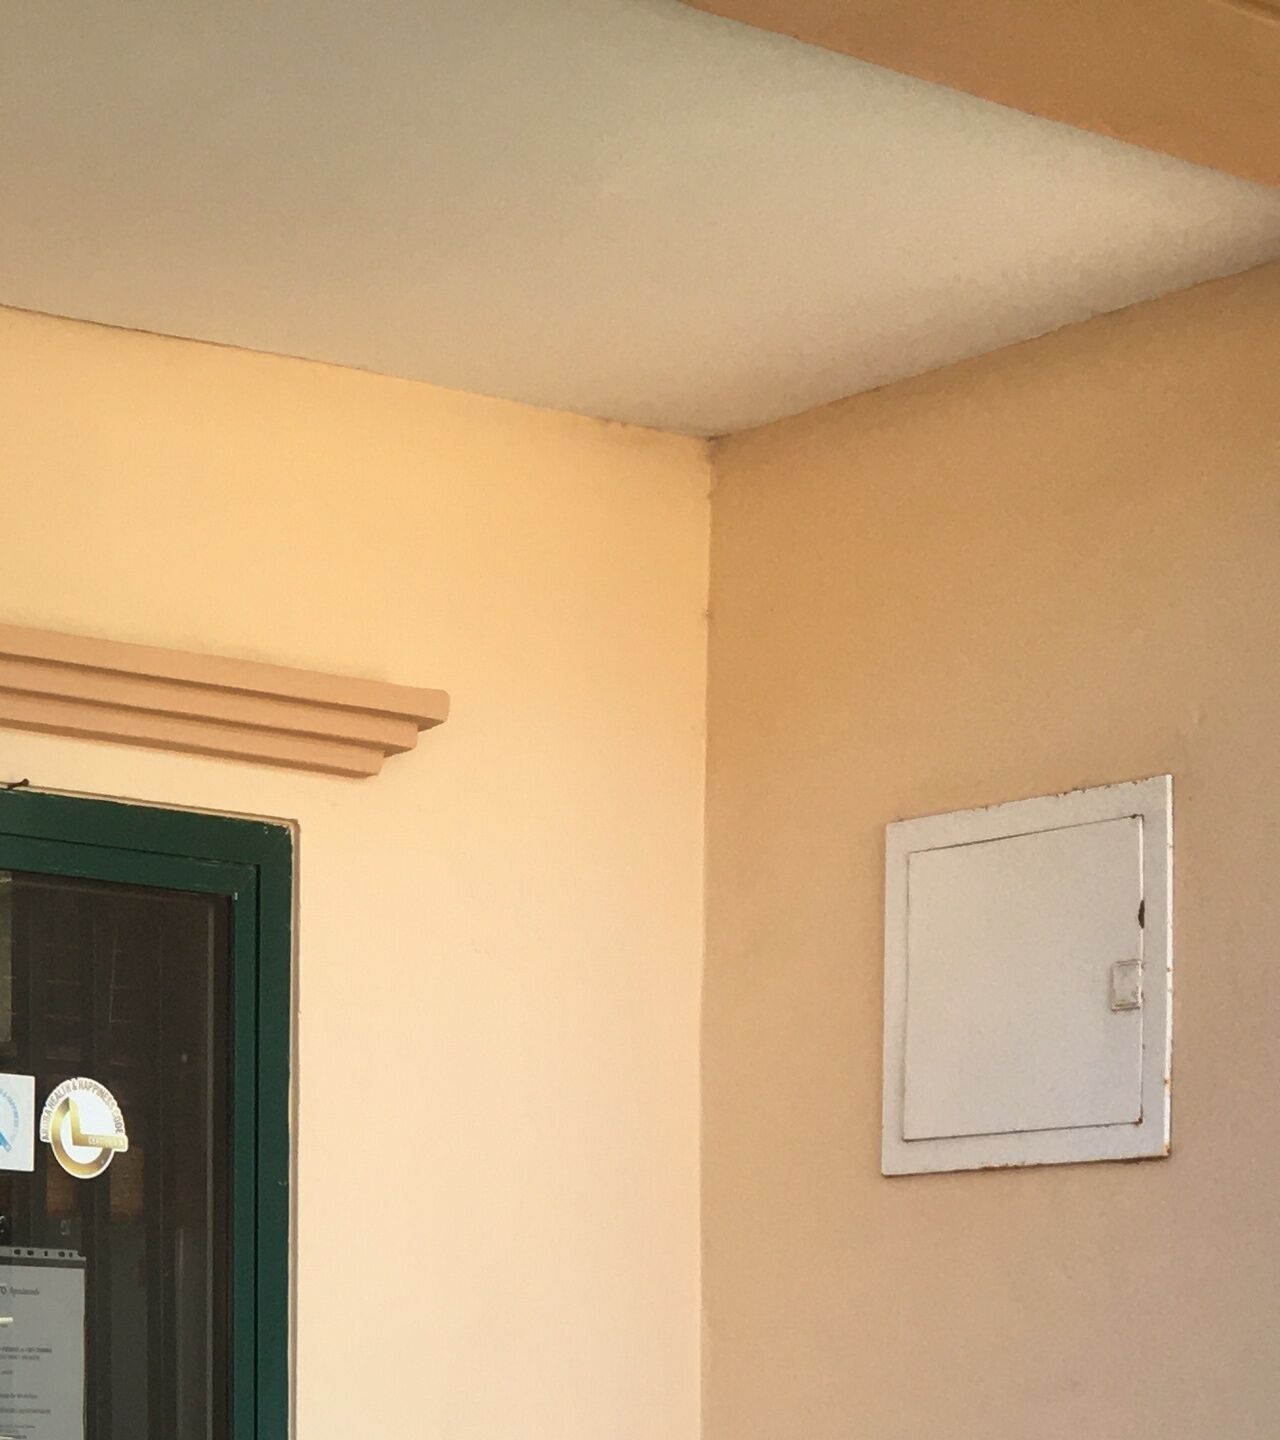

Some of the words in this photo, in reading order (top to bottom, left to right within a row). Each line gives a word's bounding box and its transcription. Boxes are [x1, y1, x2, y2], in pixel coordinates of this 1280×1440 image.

[41, 1109, 52, 1141] ARUBA
[48, 1083, 72, 1109] HEALTH
[78, 1079, 116, 1110] HAPPINESS
[111, 1109, 124, 1134] CODE
